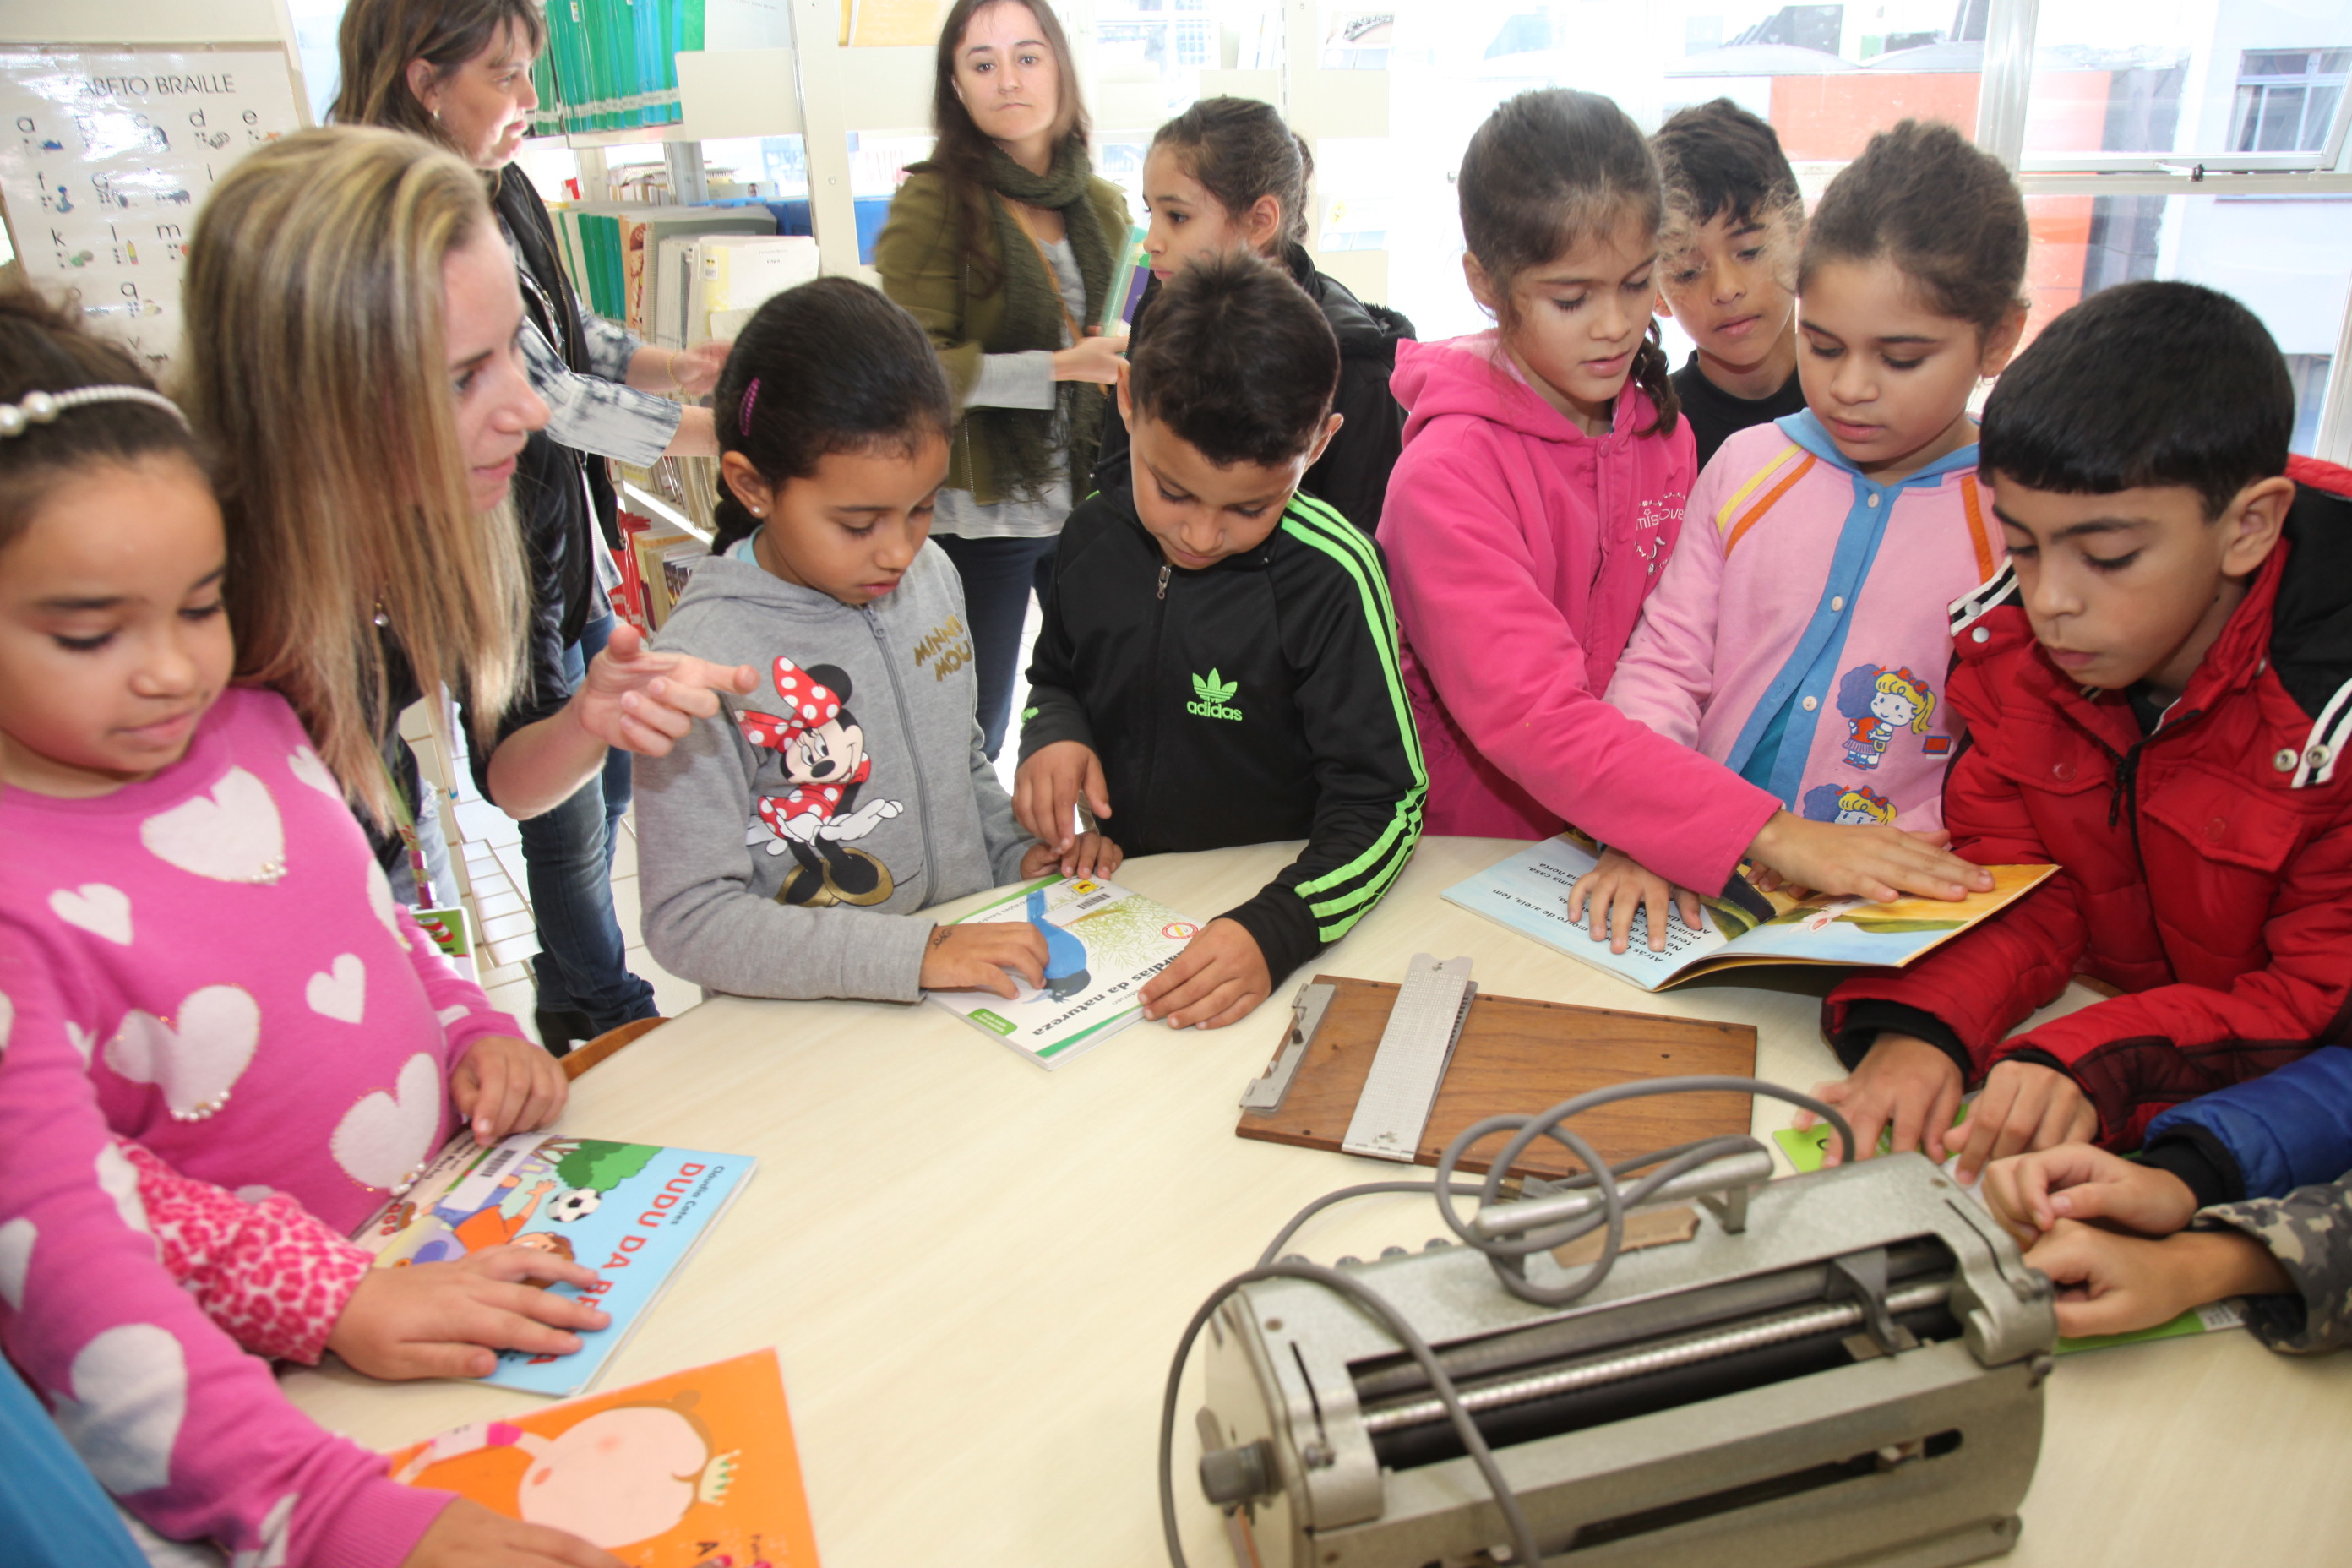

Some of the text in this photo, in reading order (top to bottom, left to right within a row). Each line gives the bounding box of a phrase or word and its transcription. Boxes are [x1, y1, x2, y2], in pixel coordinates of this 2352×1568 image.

[155, 74, 236, 95] BRAILLE
[17, 117, 36, 133] a
[189, 107, 207, 128] d
[242, 110, 259, 126] e
[51, 227, 67, 247] k
[156, 224, 182, 240] m
[1186, 700, 1243, 721] adidas
[1492, 889, 1512, 901] tem
[1542, 910, 1556, 918] de
[1666, 942, 1683, 952] No
[1670, 934, 1692, 946] tem
[1633, 948, 1663, 962] Atrás
[1107, 981, 1130, 994] da
[1032, 993, 1106, 1036] natureza
[637, 1162, 707, 1228] DUDU
[600, 1235, 648, 1269] DA
